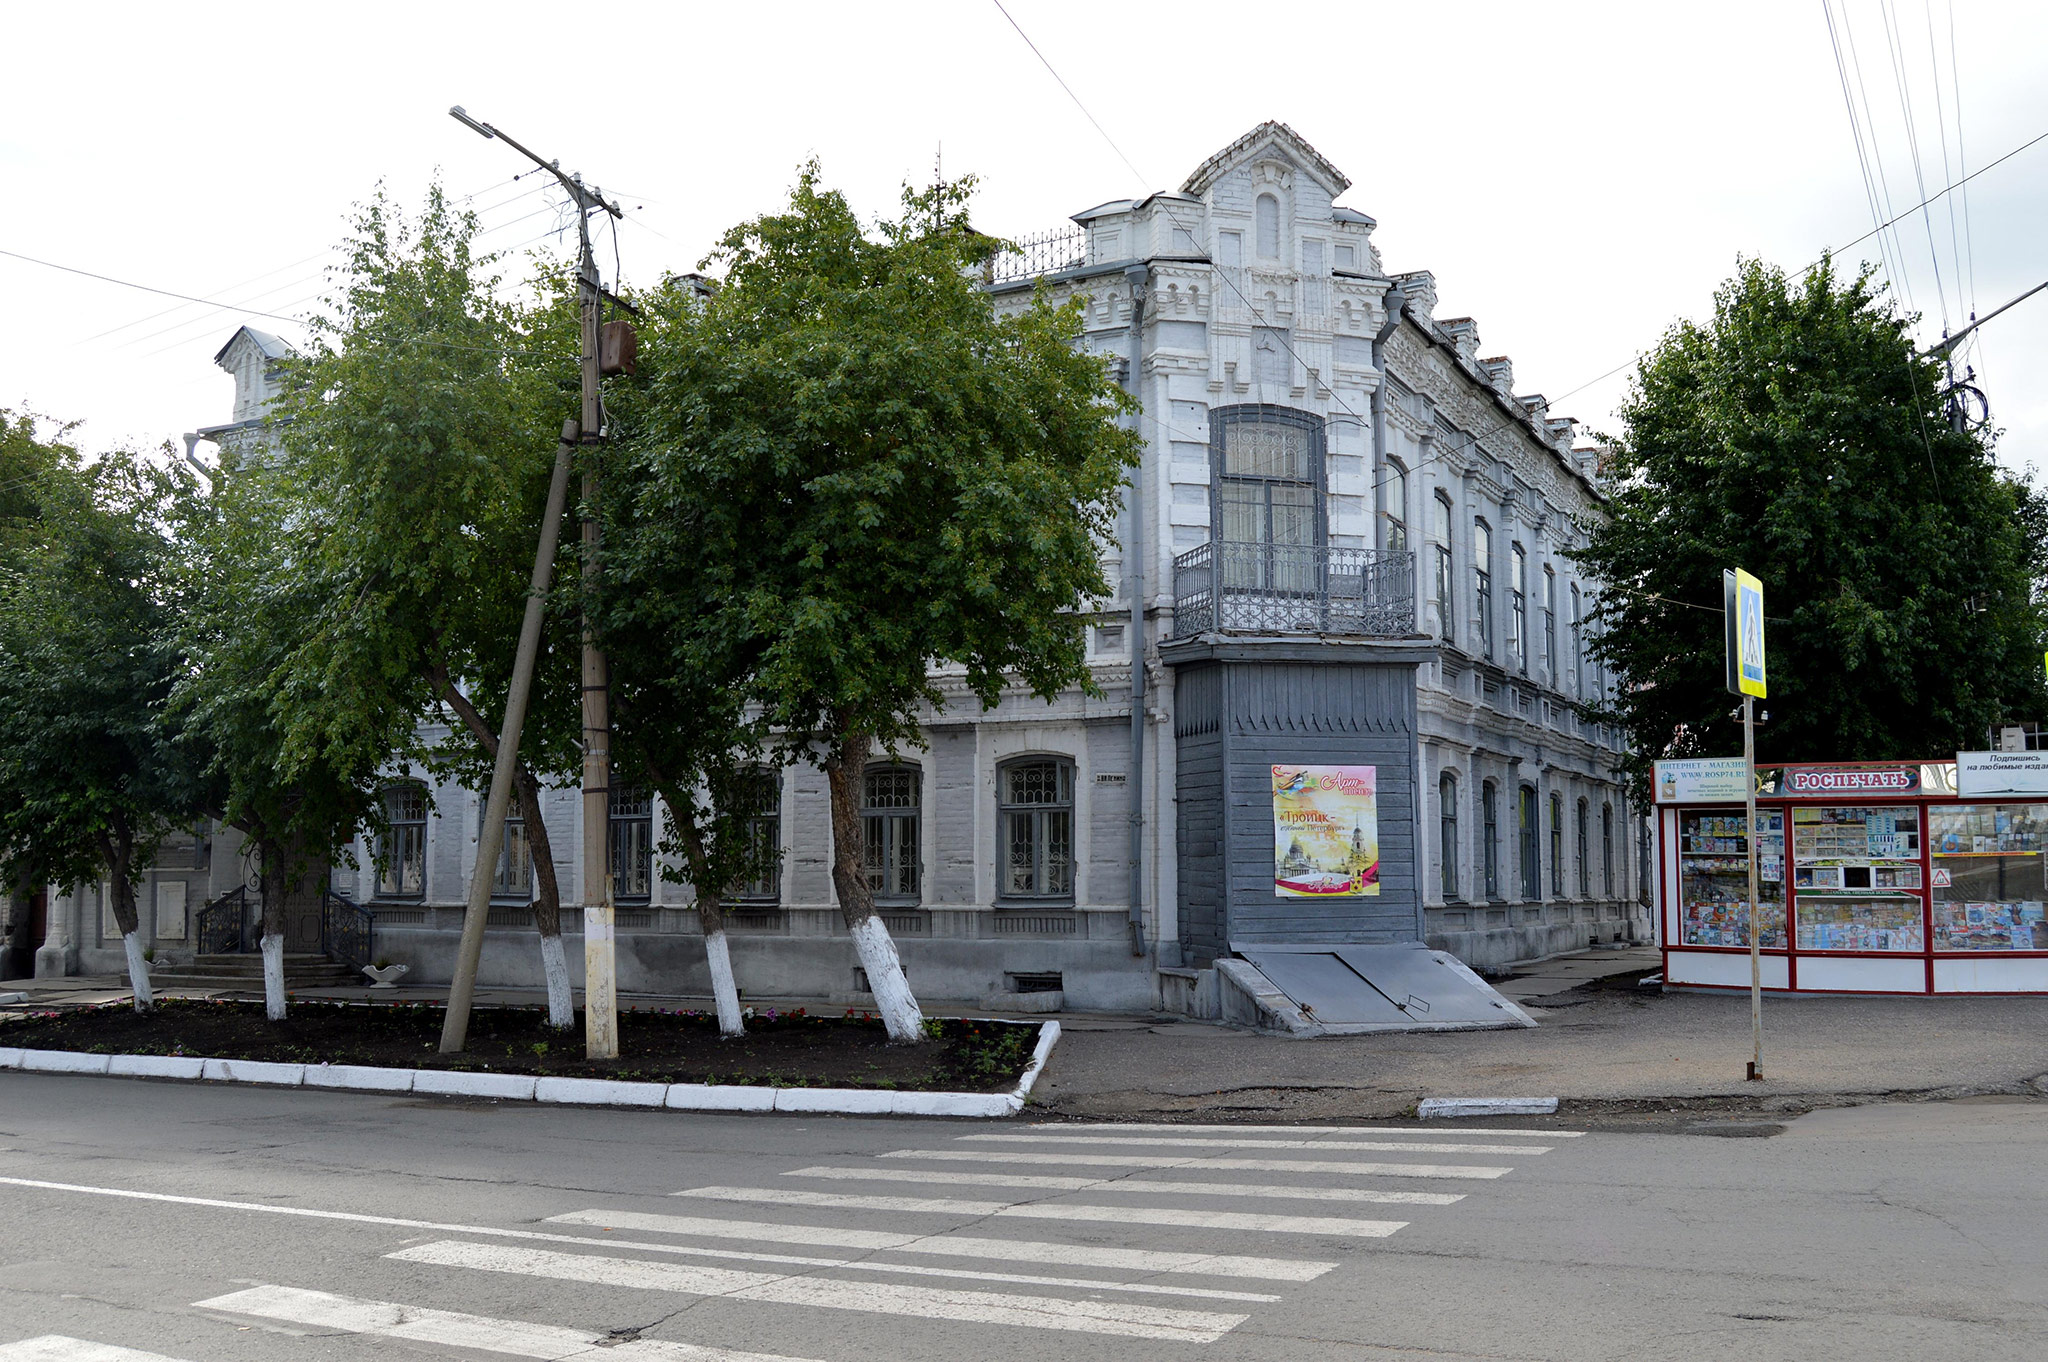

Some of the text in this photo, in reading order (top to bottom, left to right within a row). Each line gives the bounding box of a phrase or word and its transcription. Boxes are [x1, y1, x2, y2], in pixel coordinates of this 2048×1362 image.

[1989, 754, 2041, 763] Подпишись
[1660, 762, 1701, 770] ИНТЕРНЕТ
[1709, 761, 1747, 769] МАГАЗИН
[1979, 763, 2023, 771] любимые
[1795, 771, 1910, 790] РОСПЕЧАТЬ
[1279, 810, 1330, 827] «Троицк
